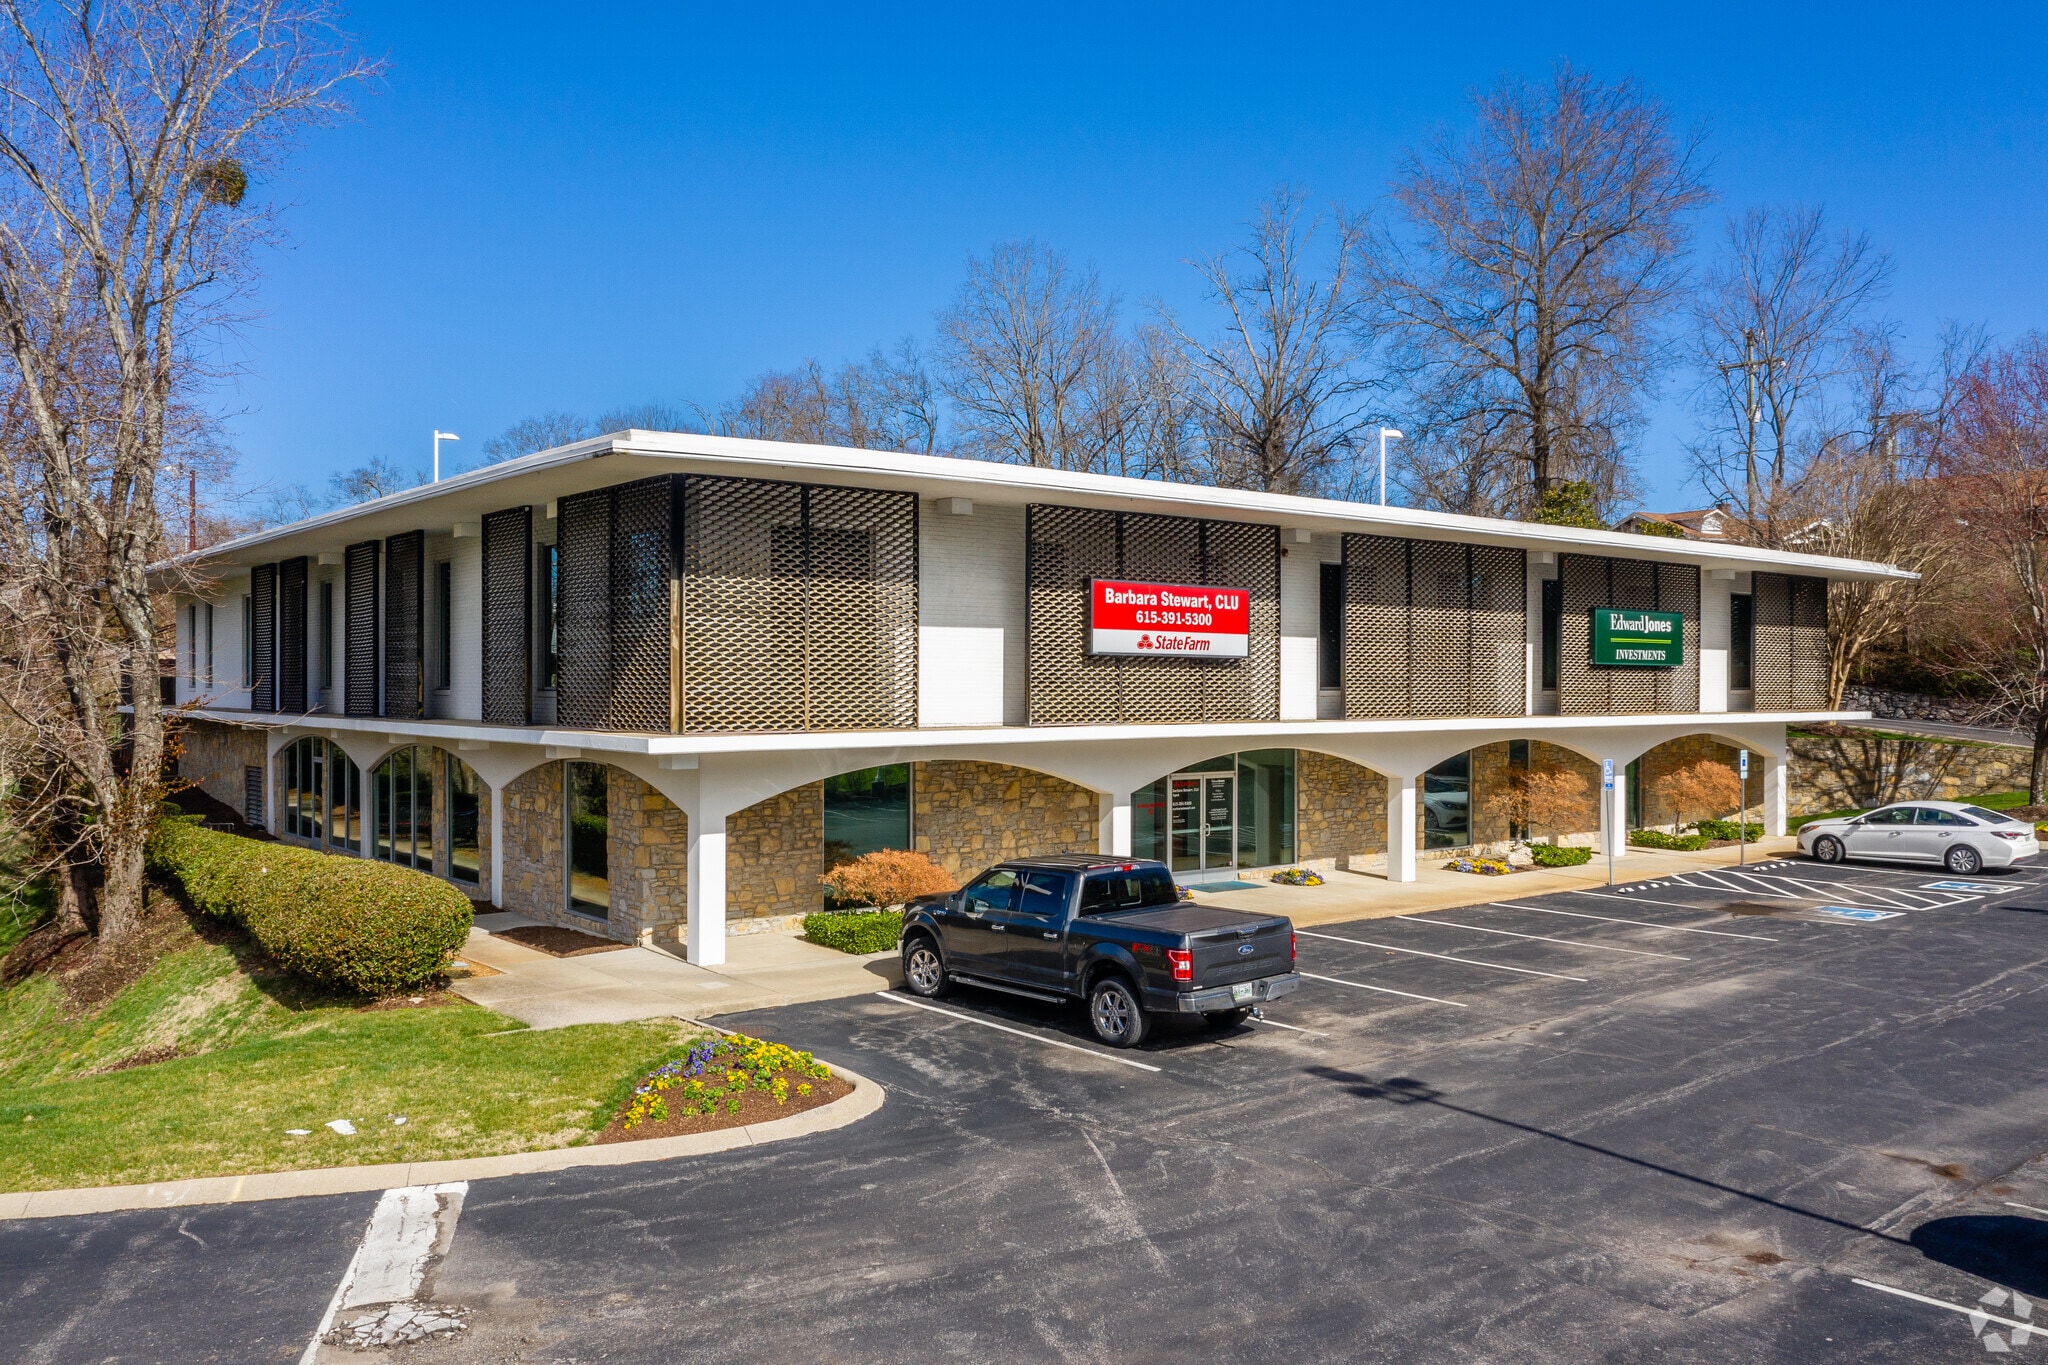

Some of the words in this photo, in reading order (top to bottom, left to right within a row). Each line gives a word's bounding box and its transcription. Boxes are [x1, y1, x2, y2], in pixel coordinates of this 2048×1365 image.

[1105, 588, 1157, 605] Barbara
[1161, 591, 1212, 611] Stewart,
[1215, 595, 1239, 610] CLU
[1136, 610, 1212, 626] 615-391-5300
[1616, 650, 1666, 660] INVESTMENTS
